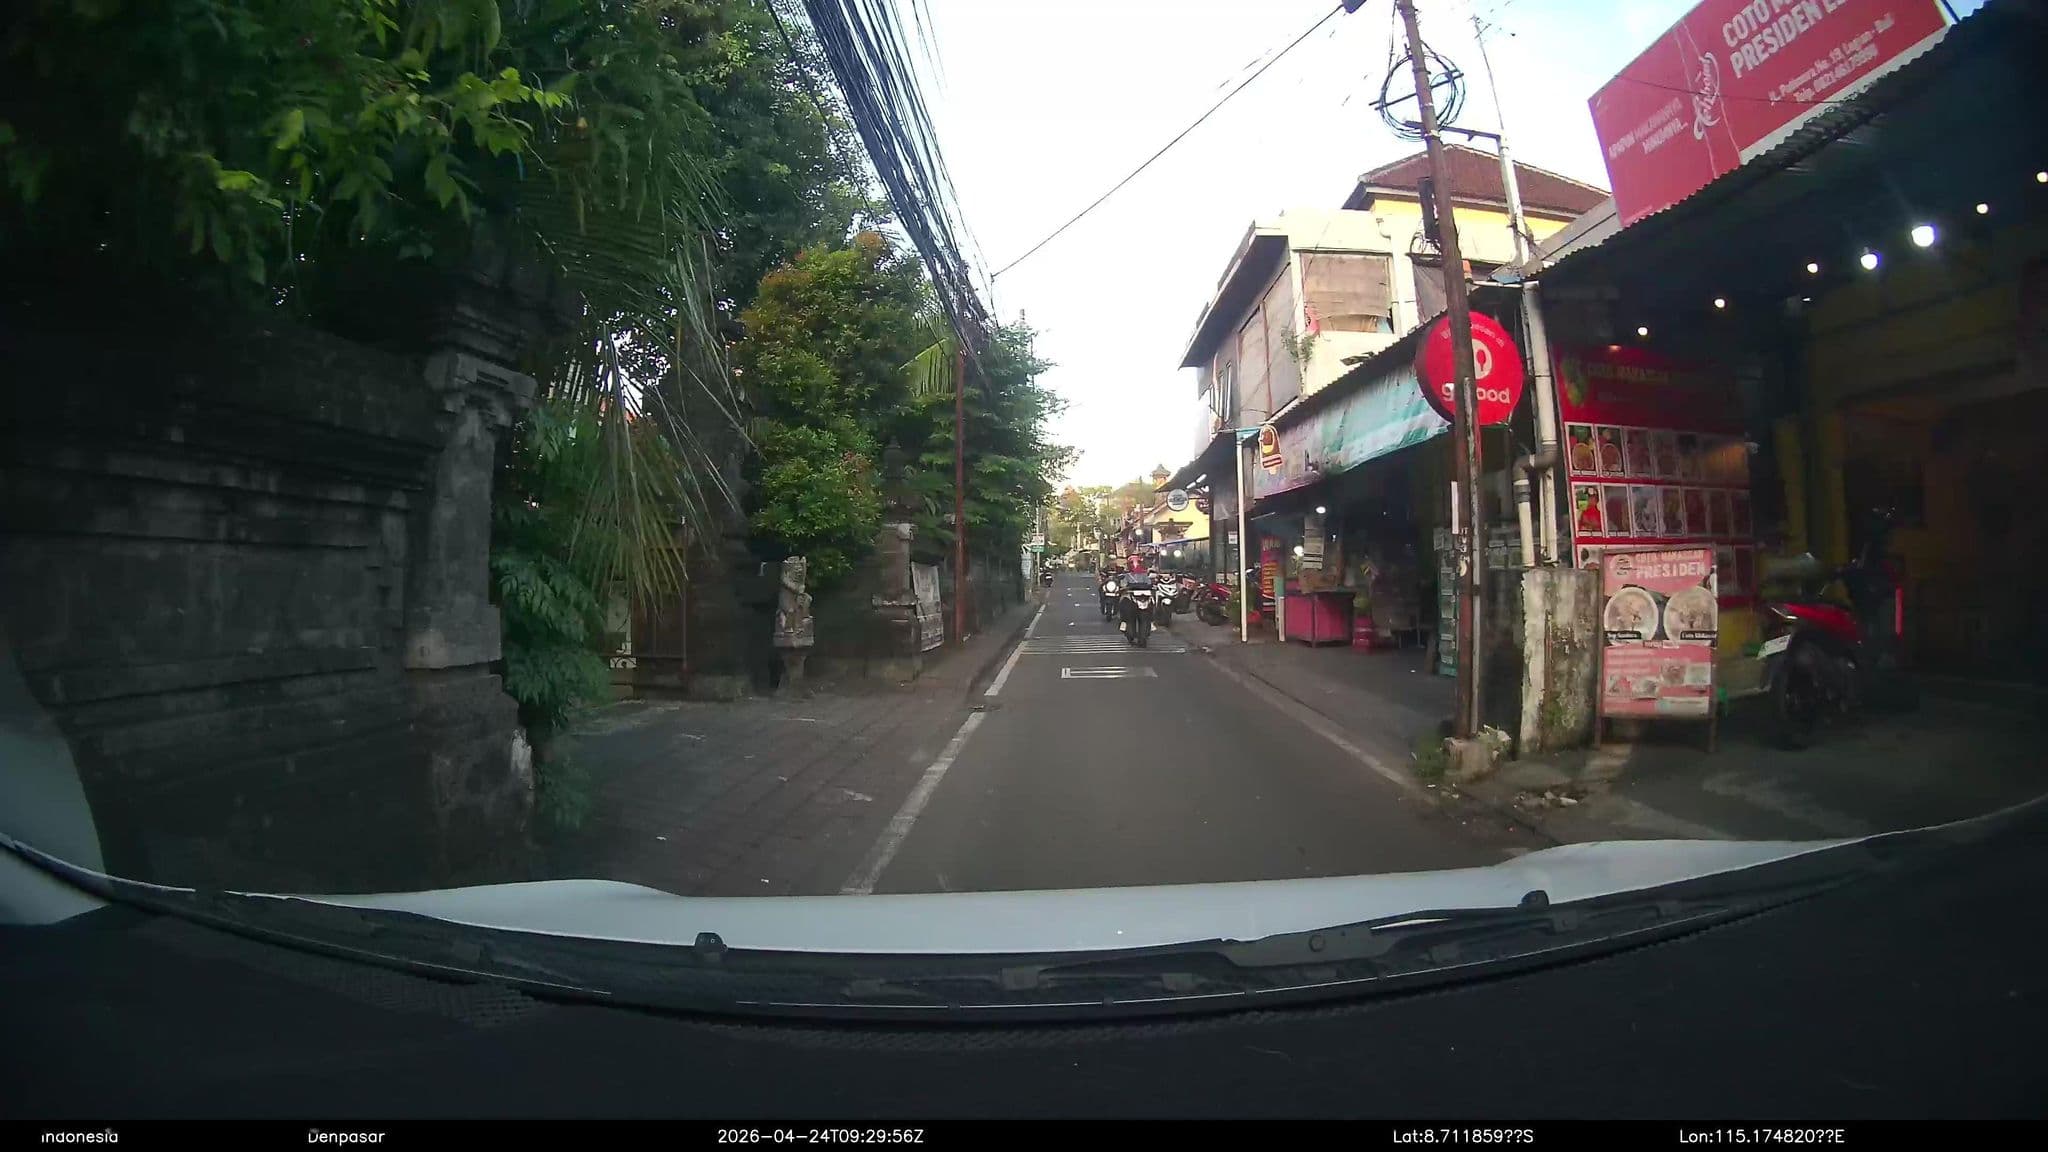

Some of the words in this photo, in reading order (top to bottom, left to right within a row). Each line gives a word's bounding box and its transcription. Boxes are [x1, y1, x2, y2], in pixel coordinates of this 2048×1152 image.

[1722, 0, 1770, 47] COTO
[1730, 0, 1822, 78] PRESIDEN
[1635, 562, 1706, 579] PRESIDEN
